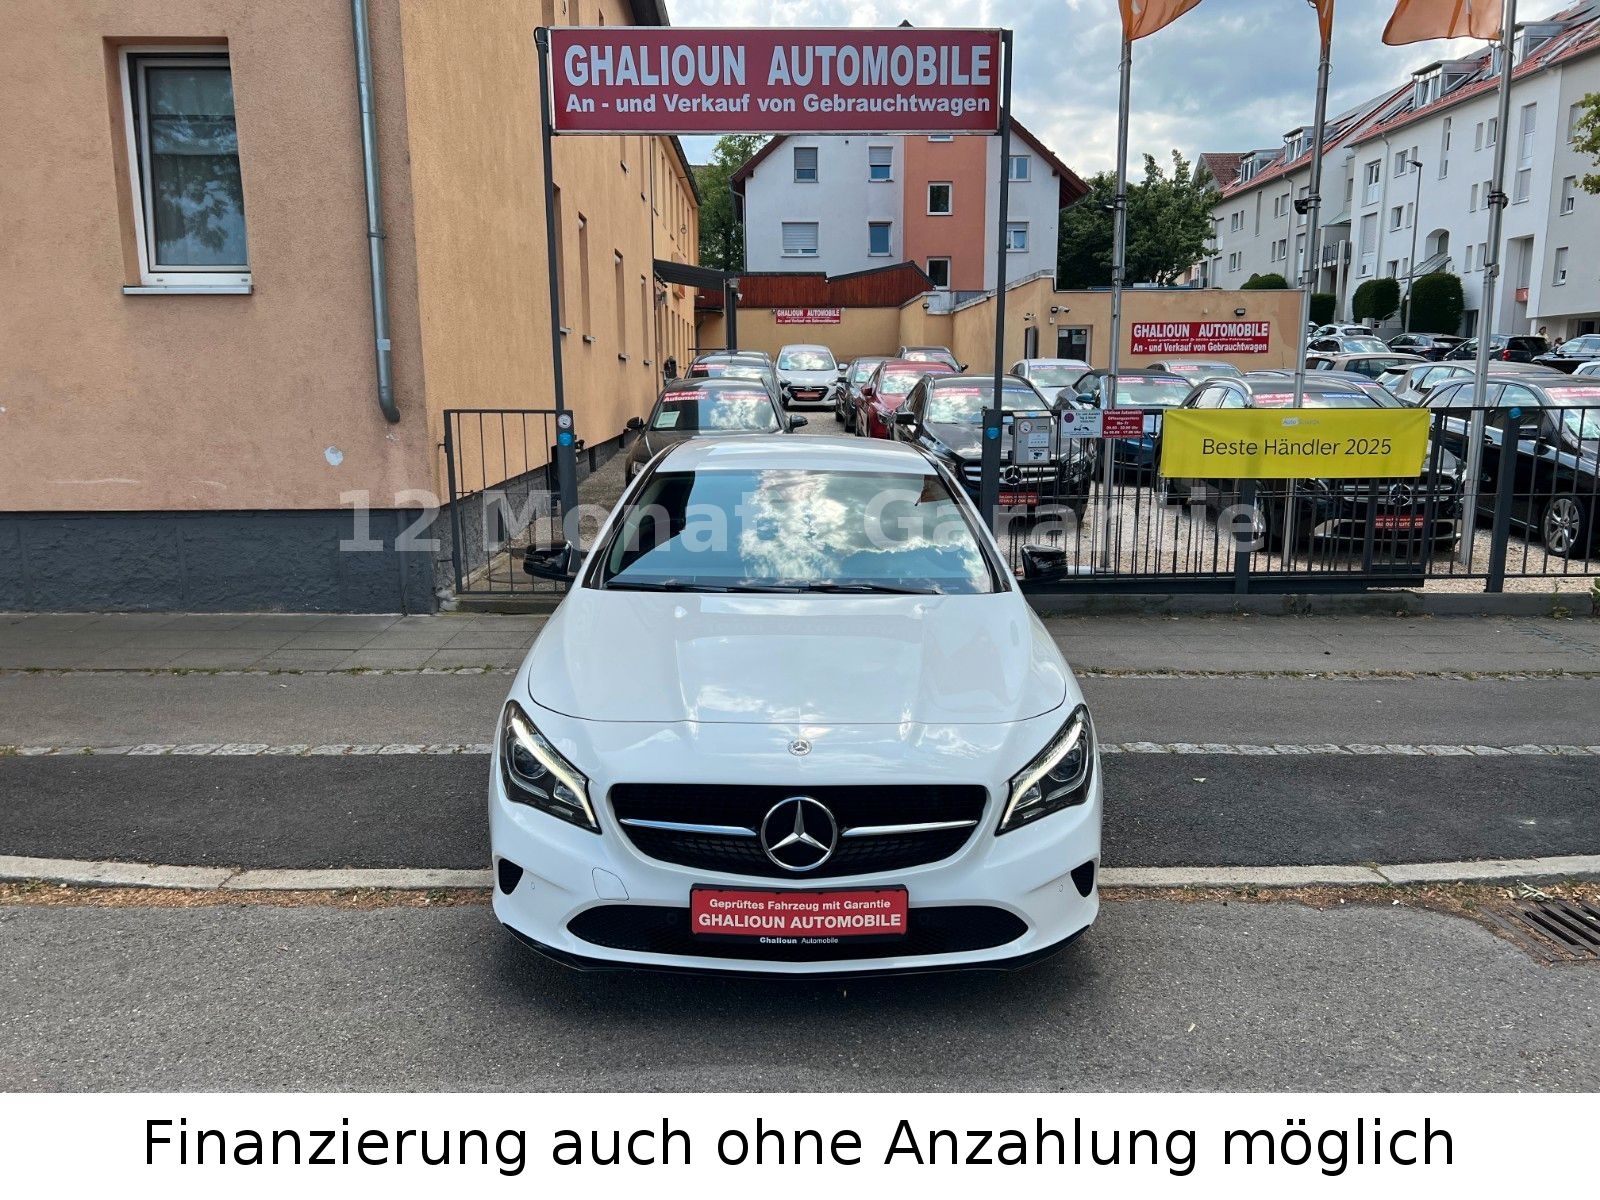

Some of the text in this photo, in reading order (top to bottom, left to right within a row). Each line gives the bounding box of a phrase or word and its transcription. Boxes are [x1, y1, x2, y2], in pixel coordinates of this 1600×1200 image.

[565, 45, 991, 86] GHALIOUN AUTOMOBILE
[566, 94, 595, 112] An
[616, 94, 656, 112] und
[663, 94, 751, 112] Verkauf
[757, 98, 796, 112] von
[803, 94, 990, 117] Gebrauchtwagen
[1134, 323, 1269, 338] GHALIOUN AUTOMOBILE
[1133, 343, 1143, 352] An
[1149, 343, 1162, 352] und
[1163, 343, 1191, 352] Verkauf
[1207, 342, 1267, 353] Gebrauchtwagen
[1203, 438, 1392, 456] Beste Händler 2025
[709, 899, 891, 911] Geprüftes Fahrzeug mit Garantie
[699, 913, 901, 928] GHALIOUN AUTOMOBILE
